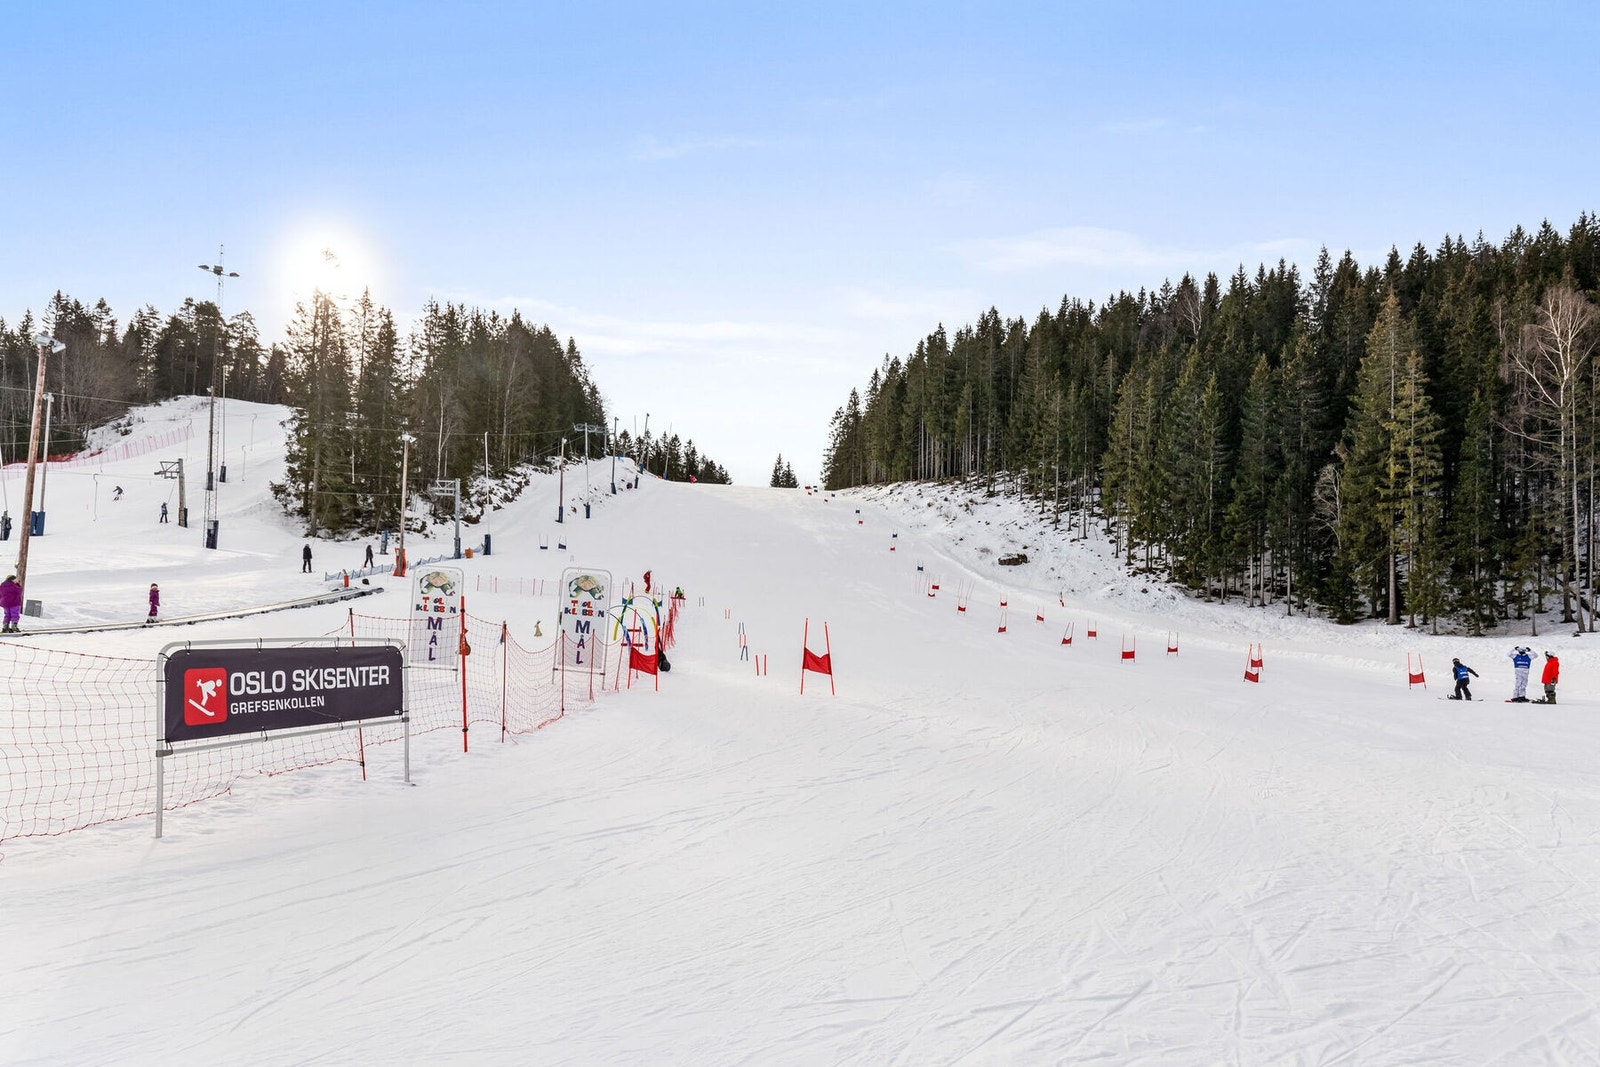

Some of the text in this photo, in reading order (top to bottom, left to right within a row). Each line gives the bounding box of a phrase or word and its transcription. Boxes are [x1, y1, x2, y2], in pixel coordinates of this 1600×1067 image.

[229, 665, 390, 696] OSLO SKISENTER
[230, 695, 325, 715] GREFSENKOLLEN
